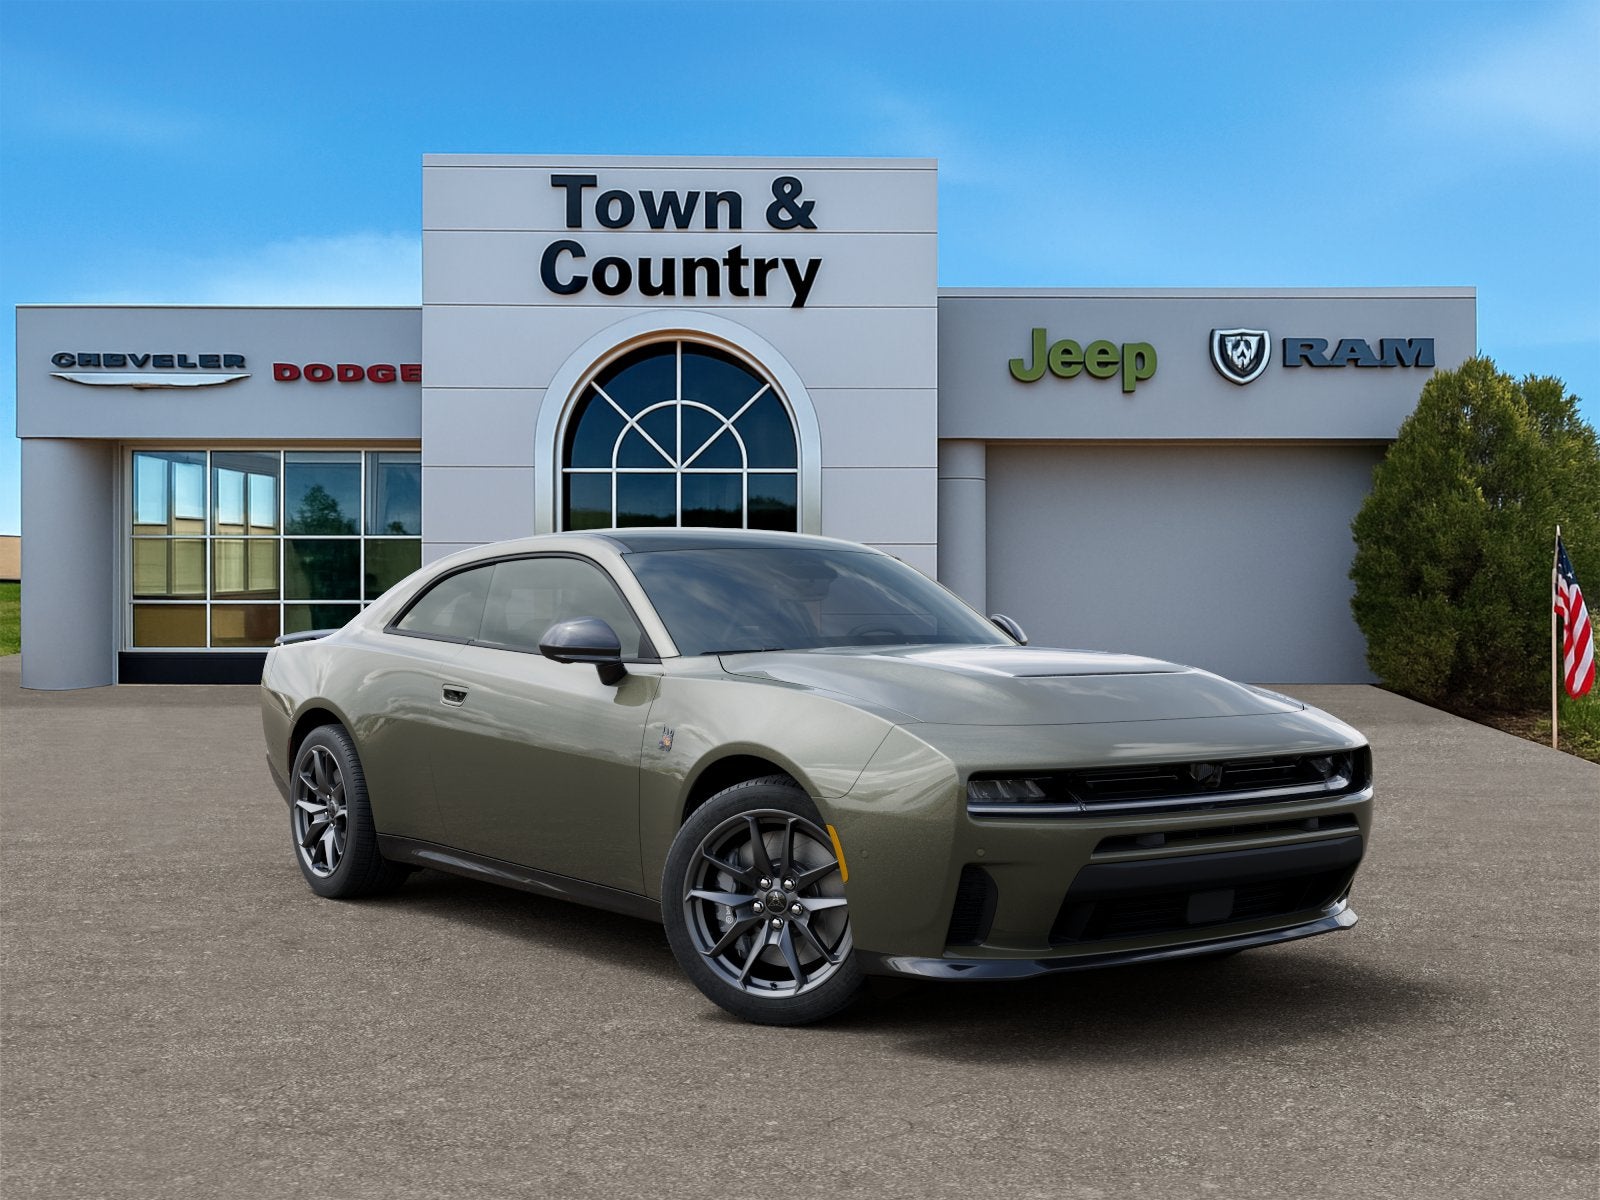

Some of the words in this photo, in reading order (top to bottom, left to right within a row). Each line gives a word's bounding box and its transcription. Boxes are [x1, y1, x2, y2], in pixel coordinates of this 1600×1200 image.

[551, 174, 742, 229] Town
[765, 176, 818, 230] &
[540, 239, 822, 308] Country
[273, 362, 422, 383] DODGE
[1009, 328, 1157, 393] Jeep
[1282, 337, 1435, 367] RAM
